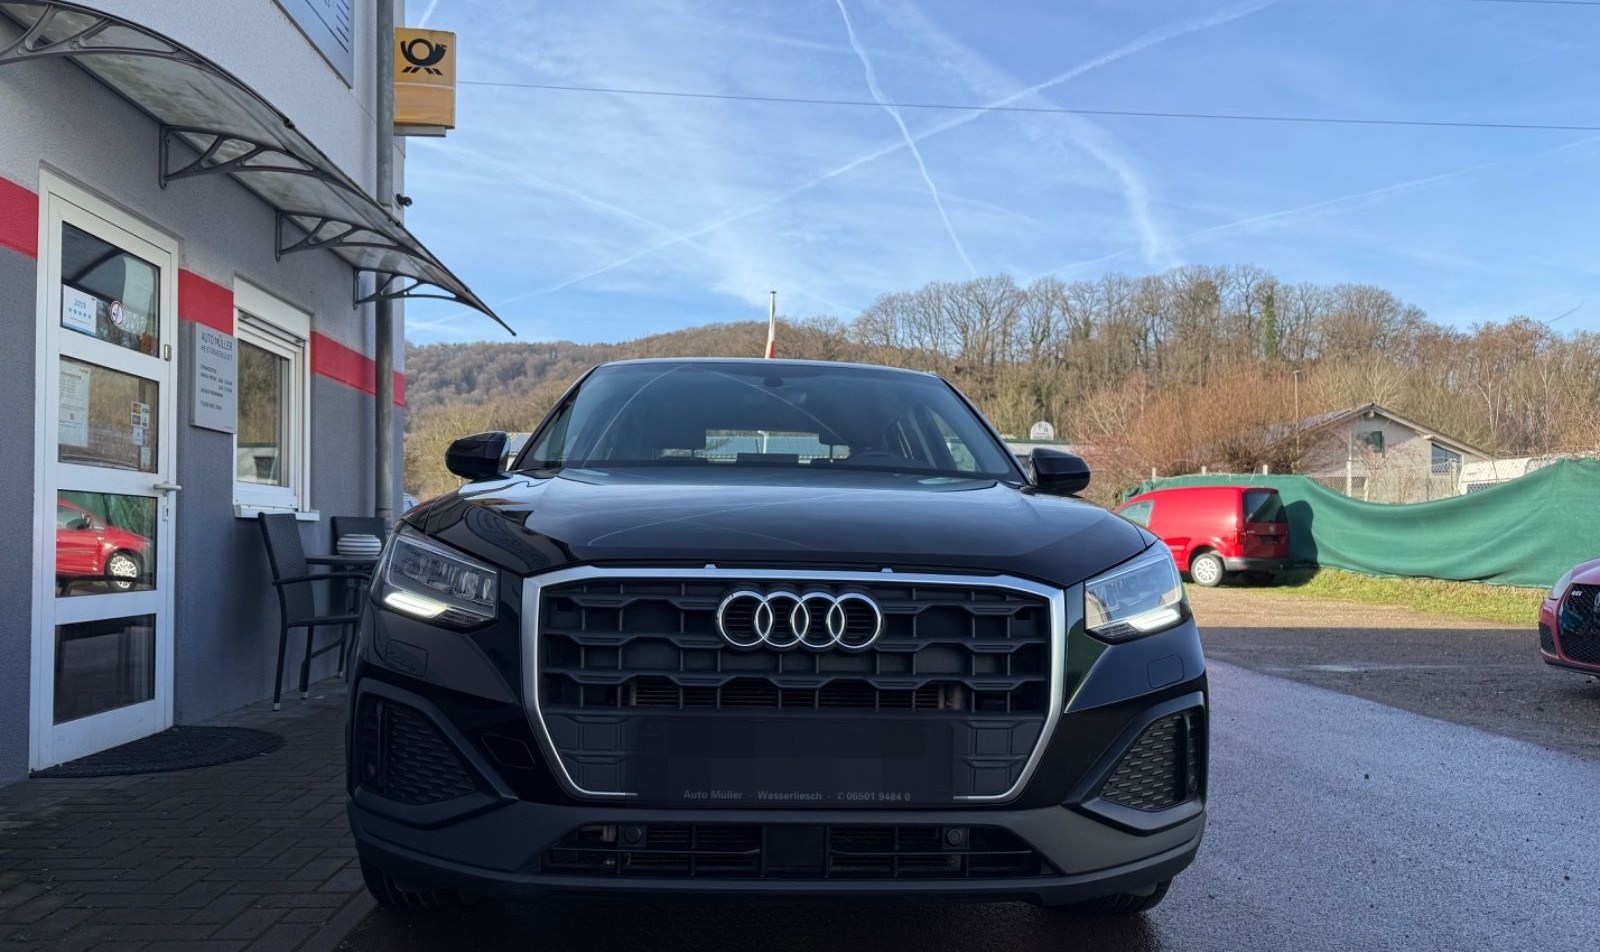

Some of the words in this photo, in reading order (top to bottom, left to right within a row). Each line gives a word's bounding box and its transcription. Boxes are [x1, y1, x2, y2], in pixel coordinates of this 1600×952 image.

[683, 789, 708, 799] Auto
[710, 789, 744, 800] Müller
[757, 790, 823, 801] Wasserliesch
[846, 791, 875, 801] 06501
[878, 791, 902, 801] 9484
[904, 792, 911, 801] 0
